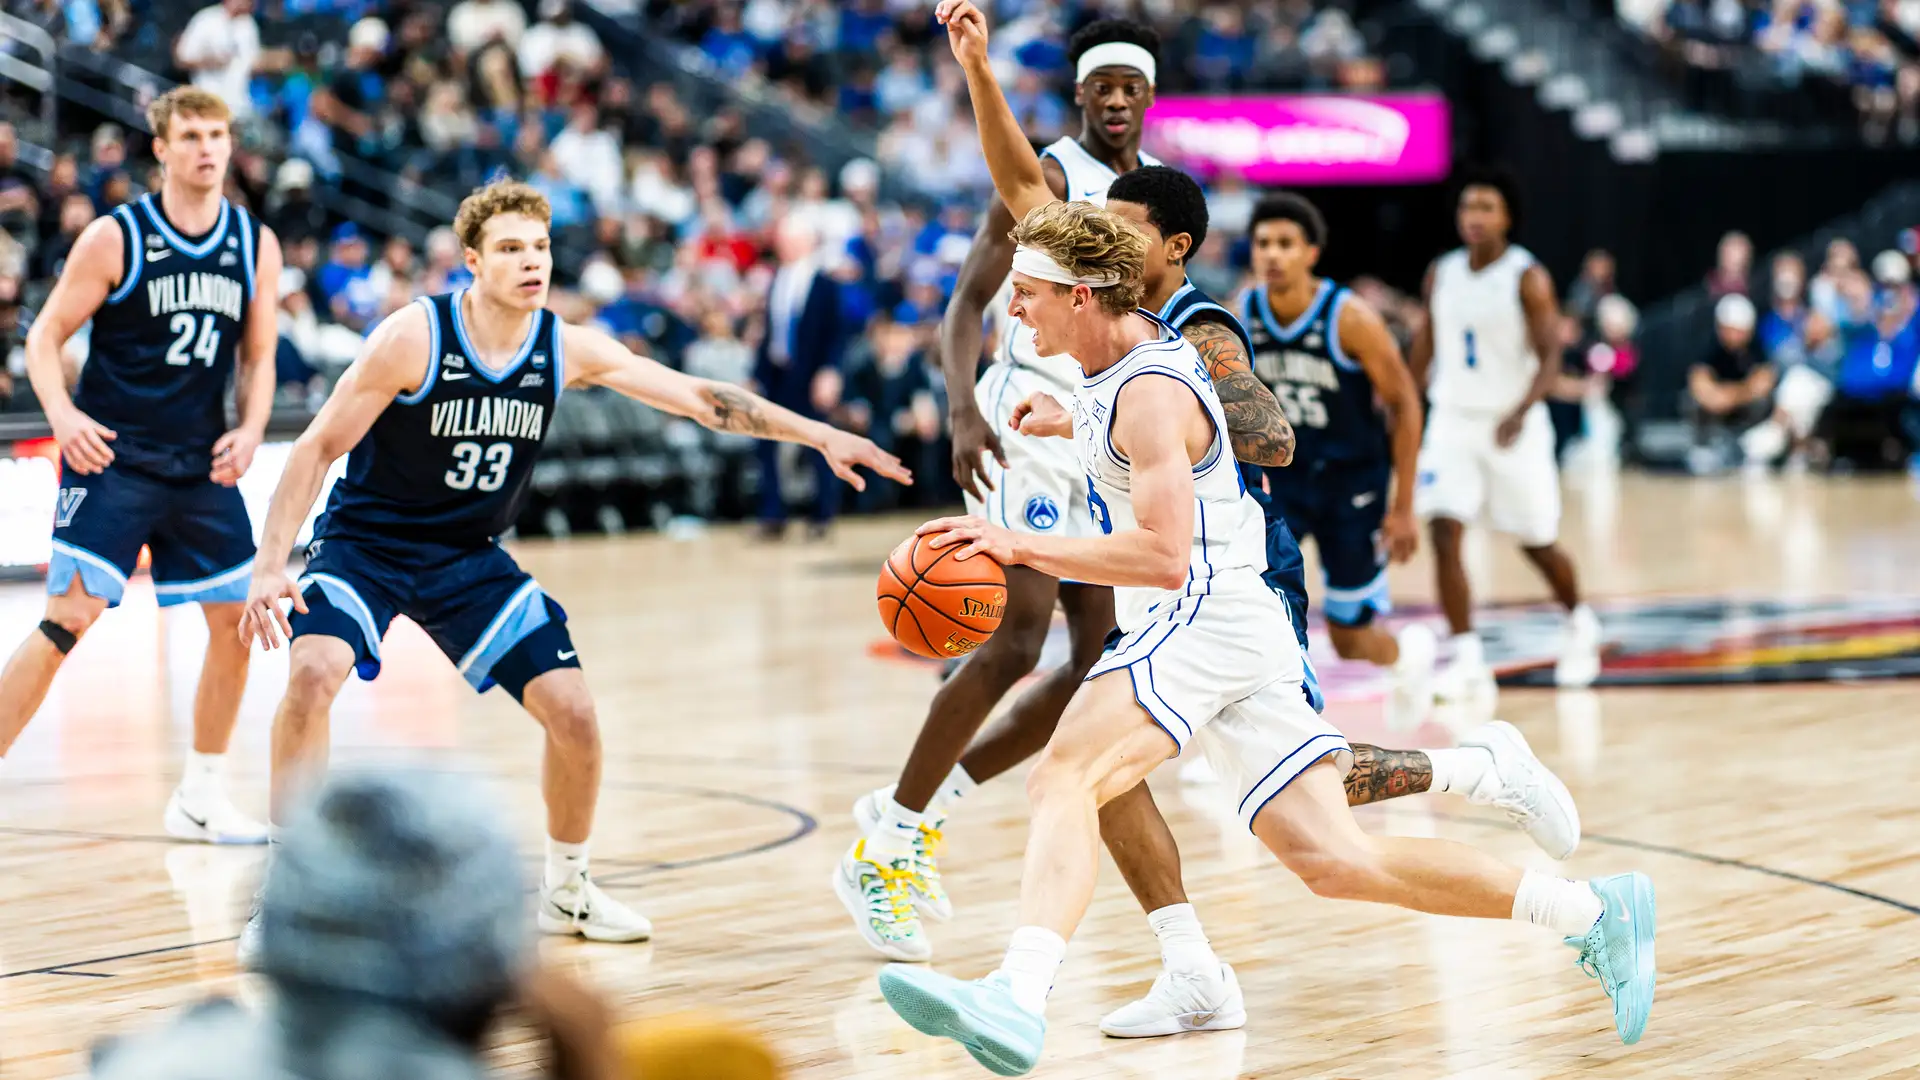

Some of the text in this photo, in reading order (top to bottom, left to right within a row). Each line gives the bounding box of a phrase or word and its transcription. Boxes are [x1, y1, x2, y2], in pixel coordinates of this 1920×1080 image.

[147, 272, 242, 321] VILLANOVA
[165, 312, 221, 367] 24
[1463, 327, 1477, 368] 1
[430, 396, 544, 441] VILLANOVA
[1275, 382, 1329, 429] 55
[444, 441, 514, 492] 33
